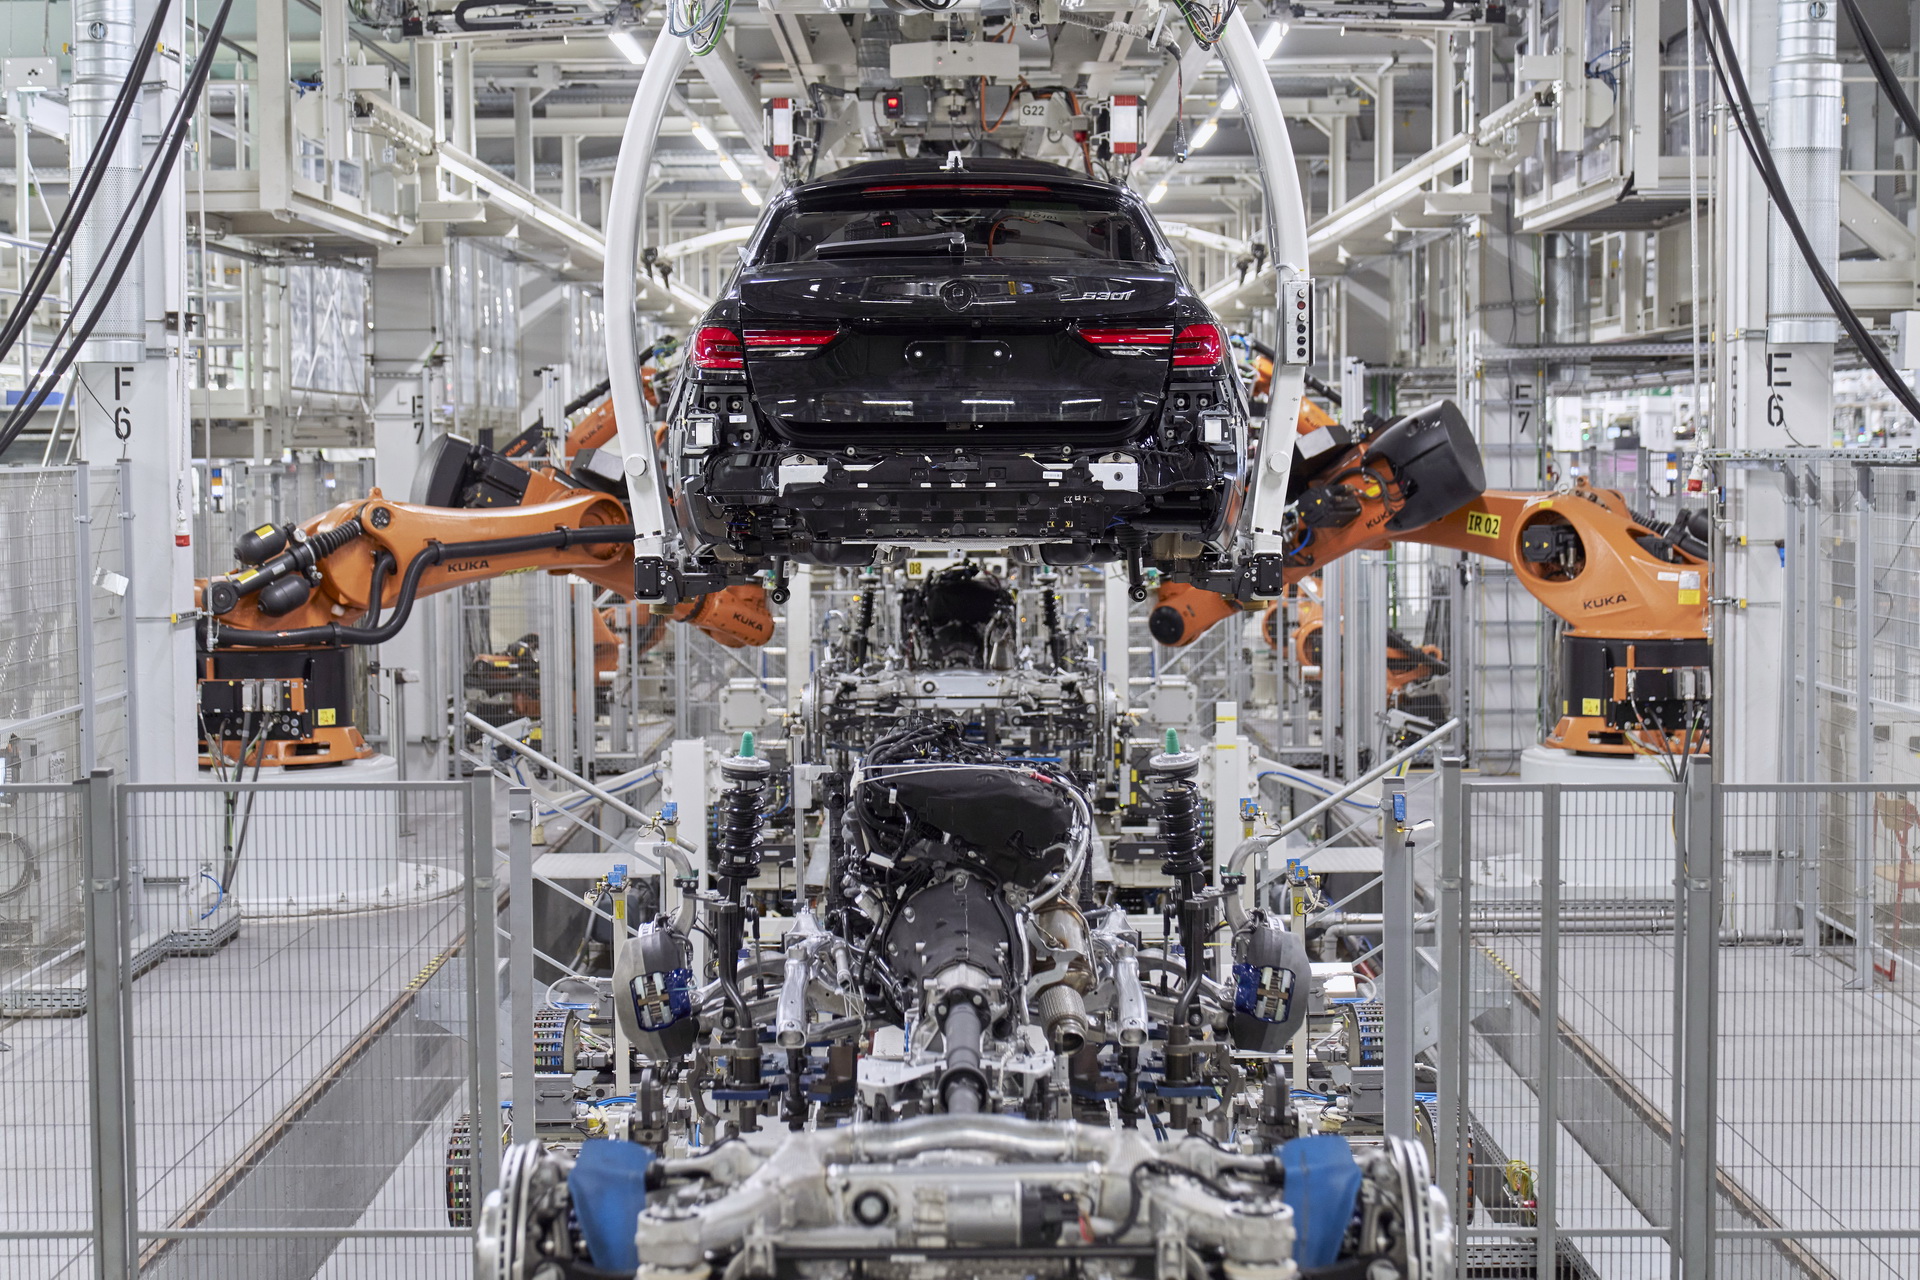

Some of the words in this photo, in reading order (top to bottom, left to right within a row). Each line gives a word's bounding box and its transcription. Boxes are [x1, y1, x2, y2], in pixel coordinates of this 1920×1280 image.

[1022, 104, 1045, 116] G22
[1767, 353, 1792, 387] E
[114, 366, 134, 401] F
[1516, 384, 1532, 408] E
[1767, 394, 1784, 427] 6
[114, 406, 132, 440] 6
[414, 422, 424, 444] 7
[1518, 411, 1530, 433] 7
[1468, 514, 1482, 532] IR
[1484, 517, 1499, 535] 02
[448, 560, 489, 573] KUKA
[1583, 593, 1627, 611] KUKA
[733, 612, 763, 632] KUKA
